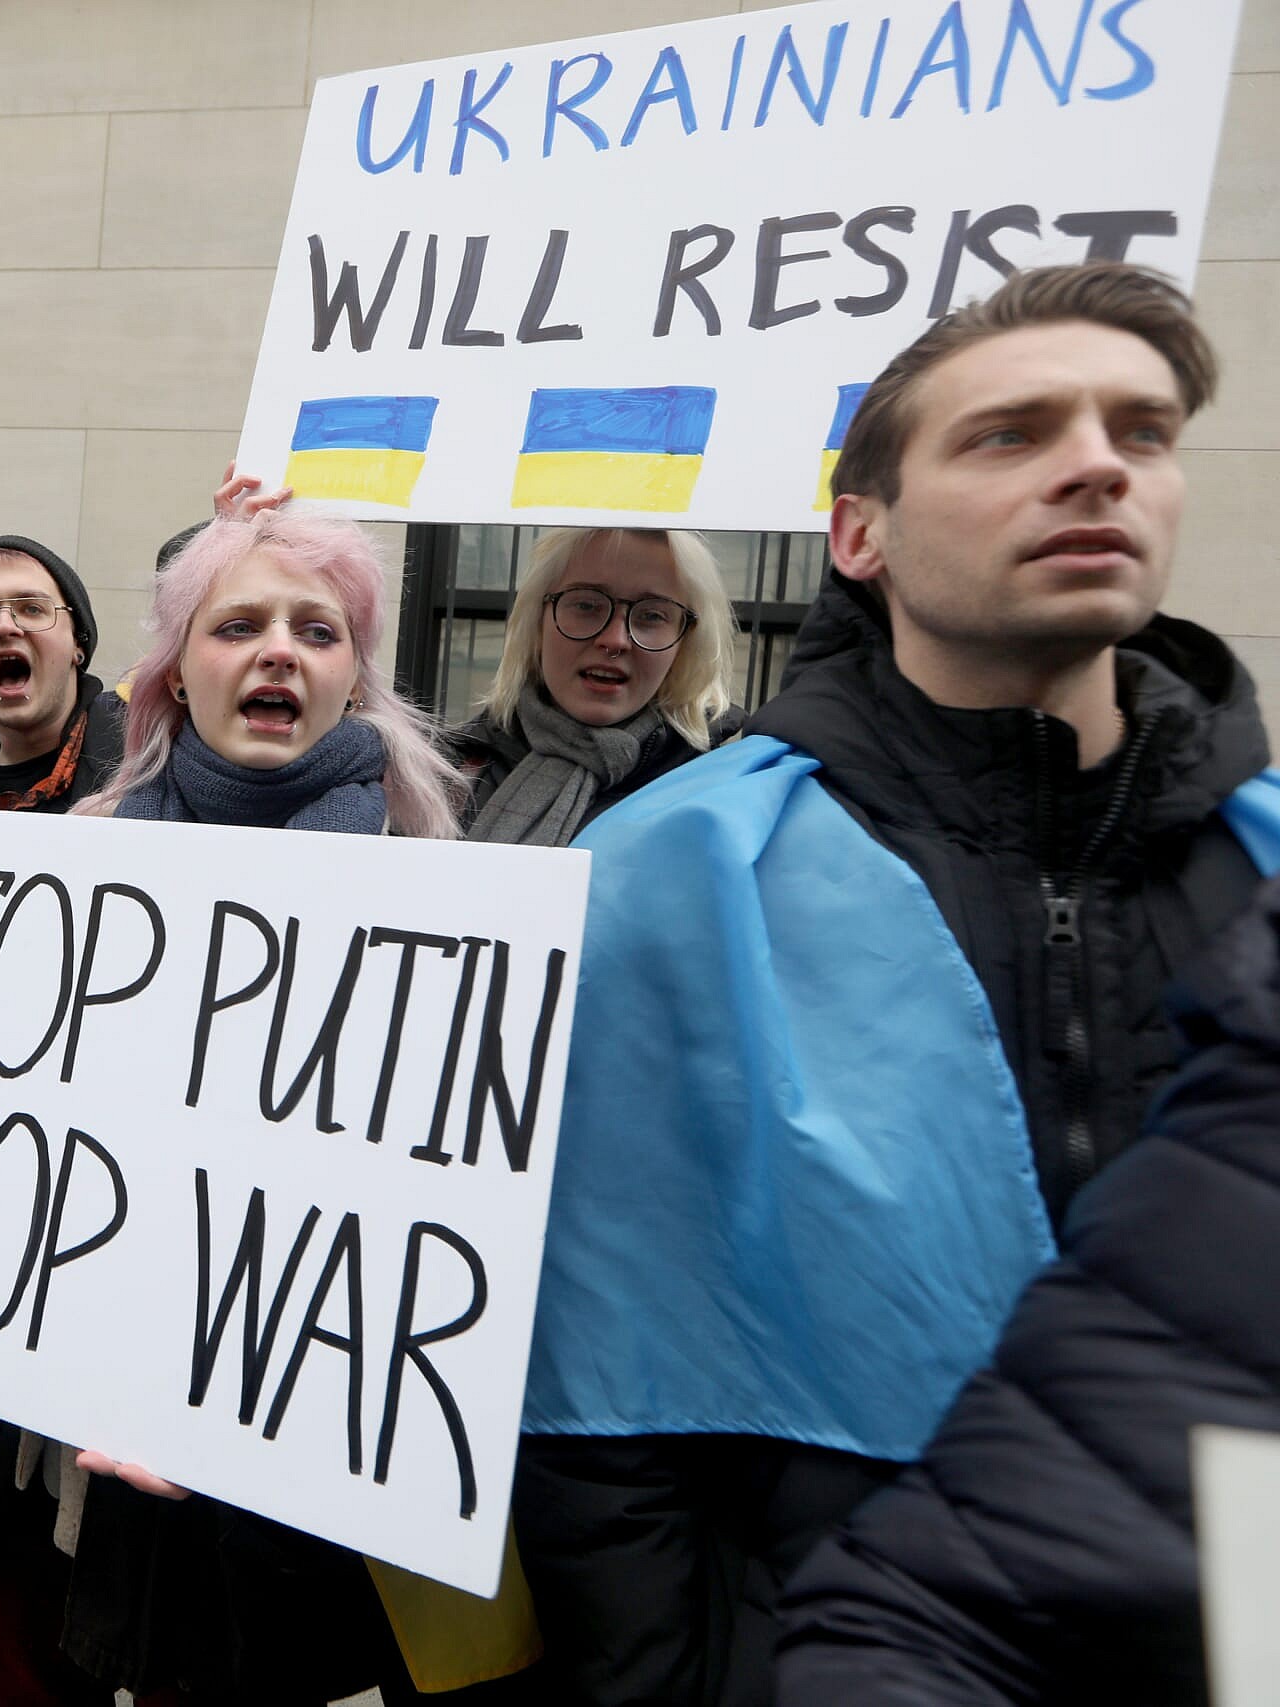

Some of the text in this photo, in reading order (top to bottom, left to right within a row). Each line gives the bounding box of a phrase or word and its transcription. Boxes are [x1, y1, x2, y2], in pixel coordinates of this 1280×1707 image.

[357, 0, 1156, 176] UKRAINIANS
[307, 229, 584, 353] WILL
[185, 900, 567, 1173] PUTIN
[187, 1167, 488, 1519] WAR
